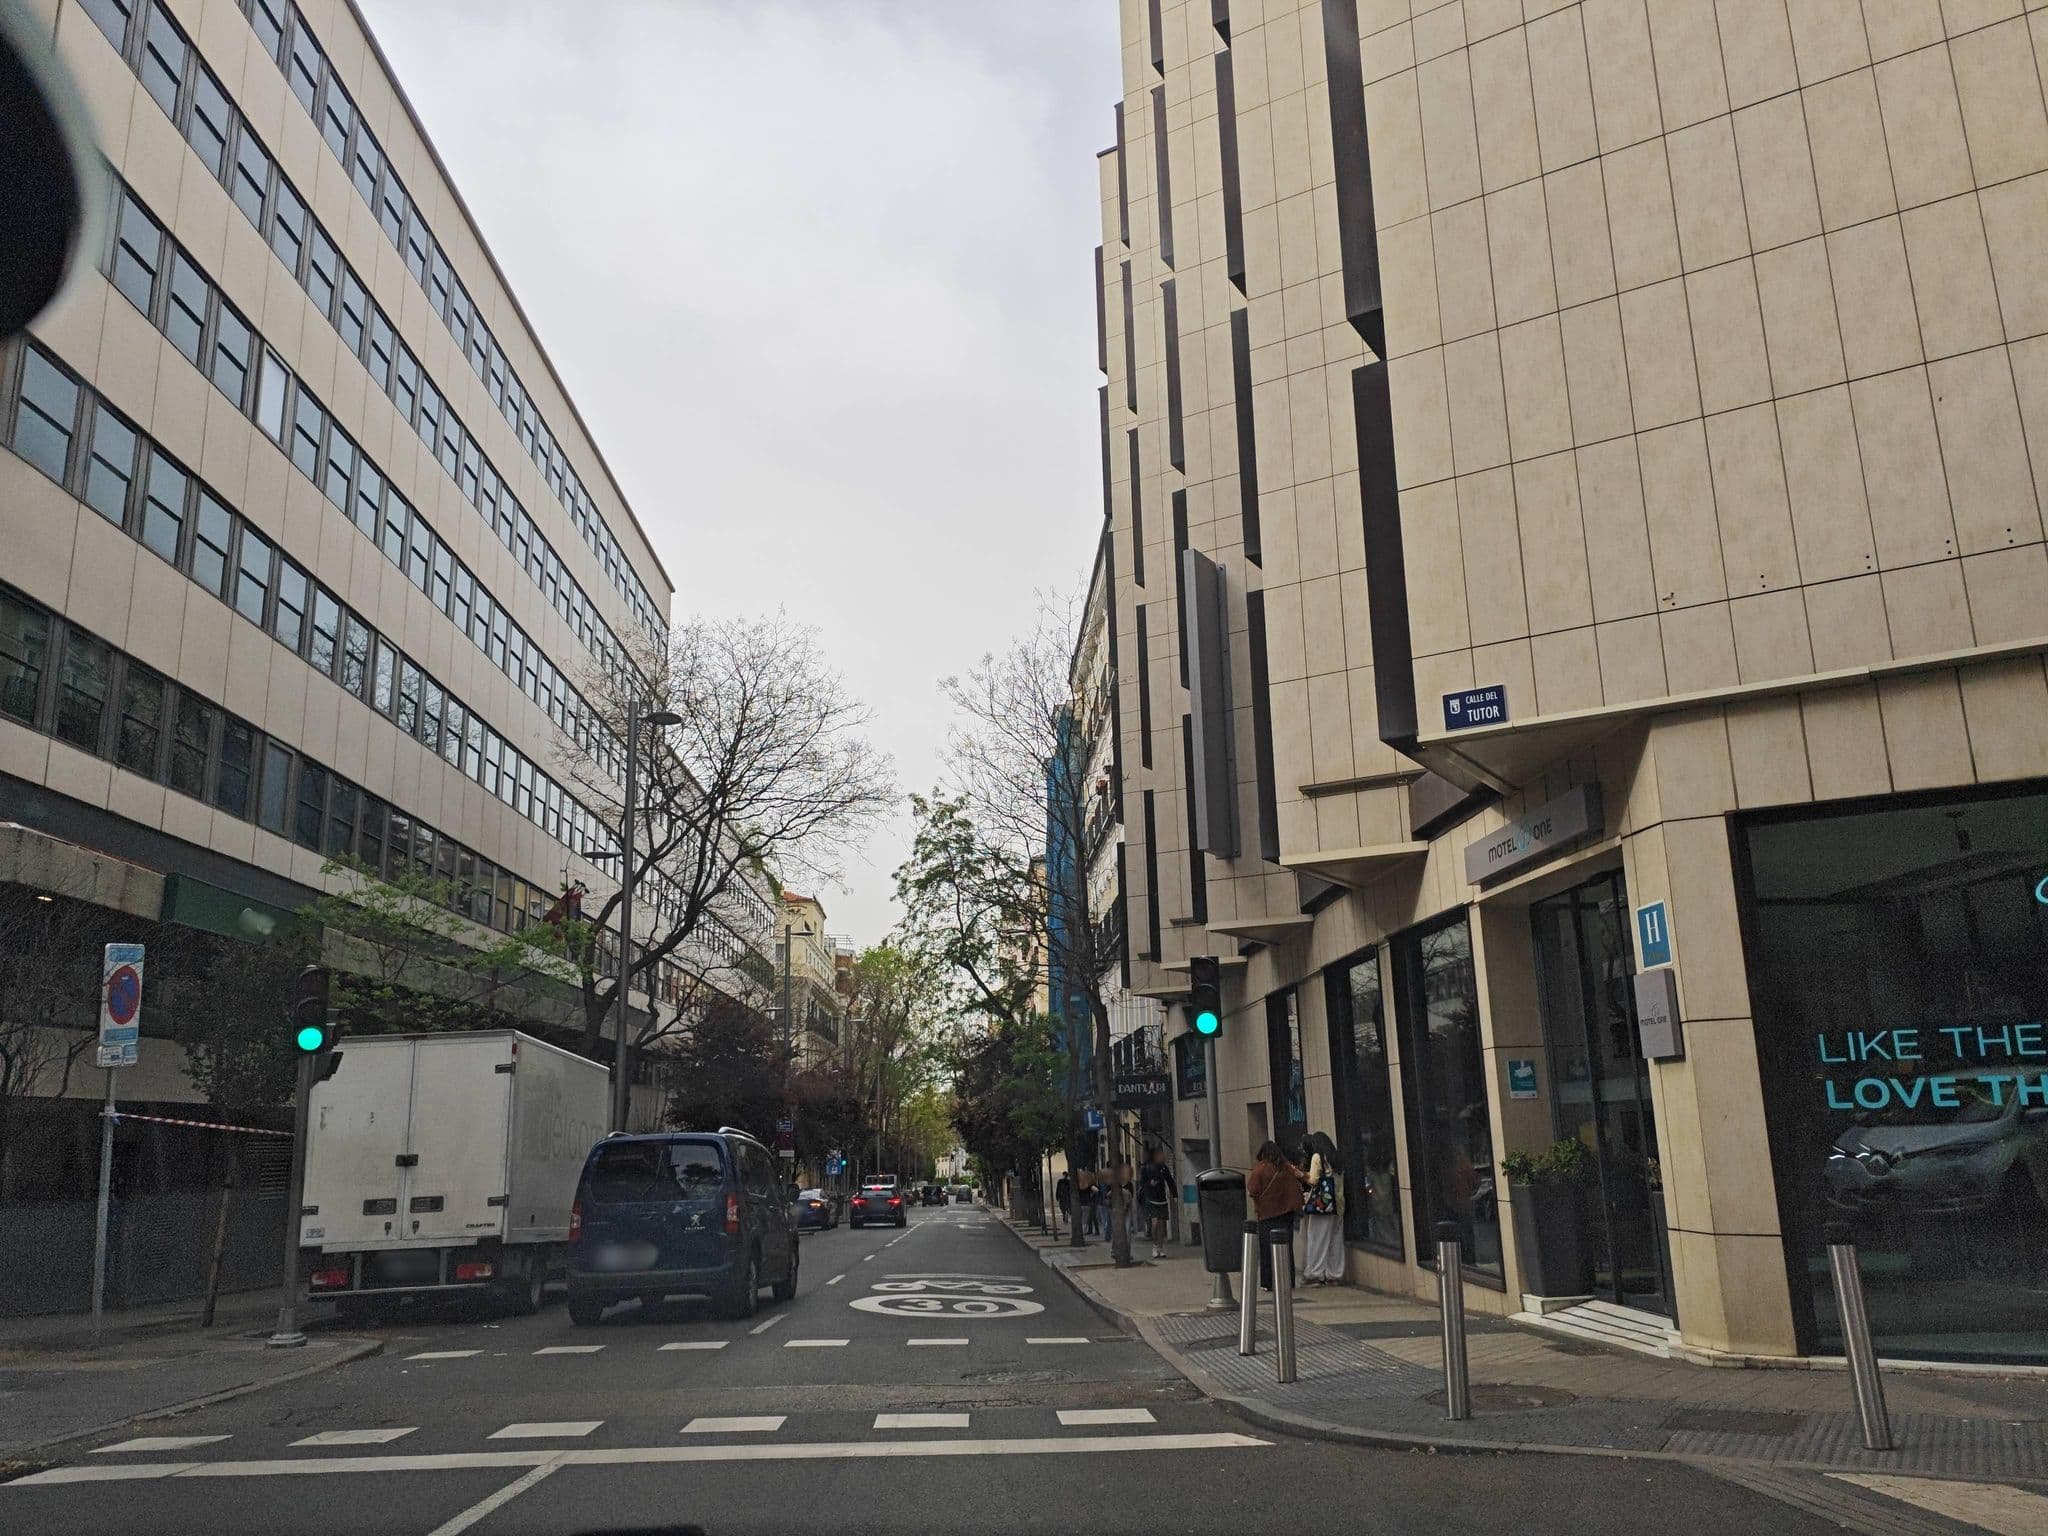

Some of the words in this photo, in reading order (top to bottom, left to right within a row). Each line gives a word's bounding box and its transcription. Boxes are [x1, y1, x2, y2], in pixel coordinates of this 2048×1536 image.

[1465, 693, 1485, 705] CALLE
[1485, 691, 1499, 701] DEL
[1466, 705, 1500, 722] TUTOR
[1488, 836, 1518, 864] MOTEL
[1532, 818, 1553, 841] ONE
[1645, 910, 1662, 945] H
[1640, 1017, 1657, 1027] MOTEL
[1657, 1015, 1667, 1025] ONE
[1818, 1029, 1922, 1063] LIKE
[1939, 1023, 2048, 1058] THE
[1825, 1076, 1961, 1110] LOVE
[897, 1299, 1000, 1313] 30
